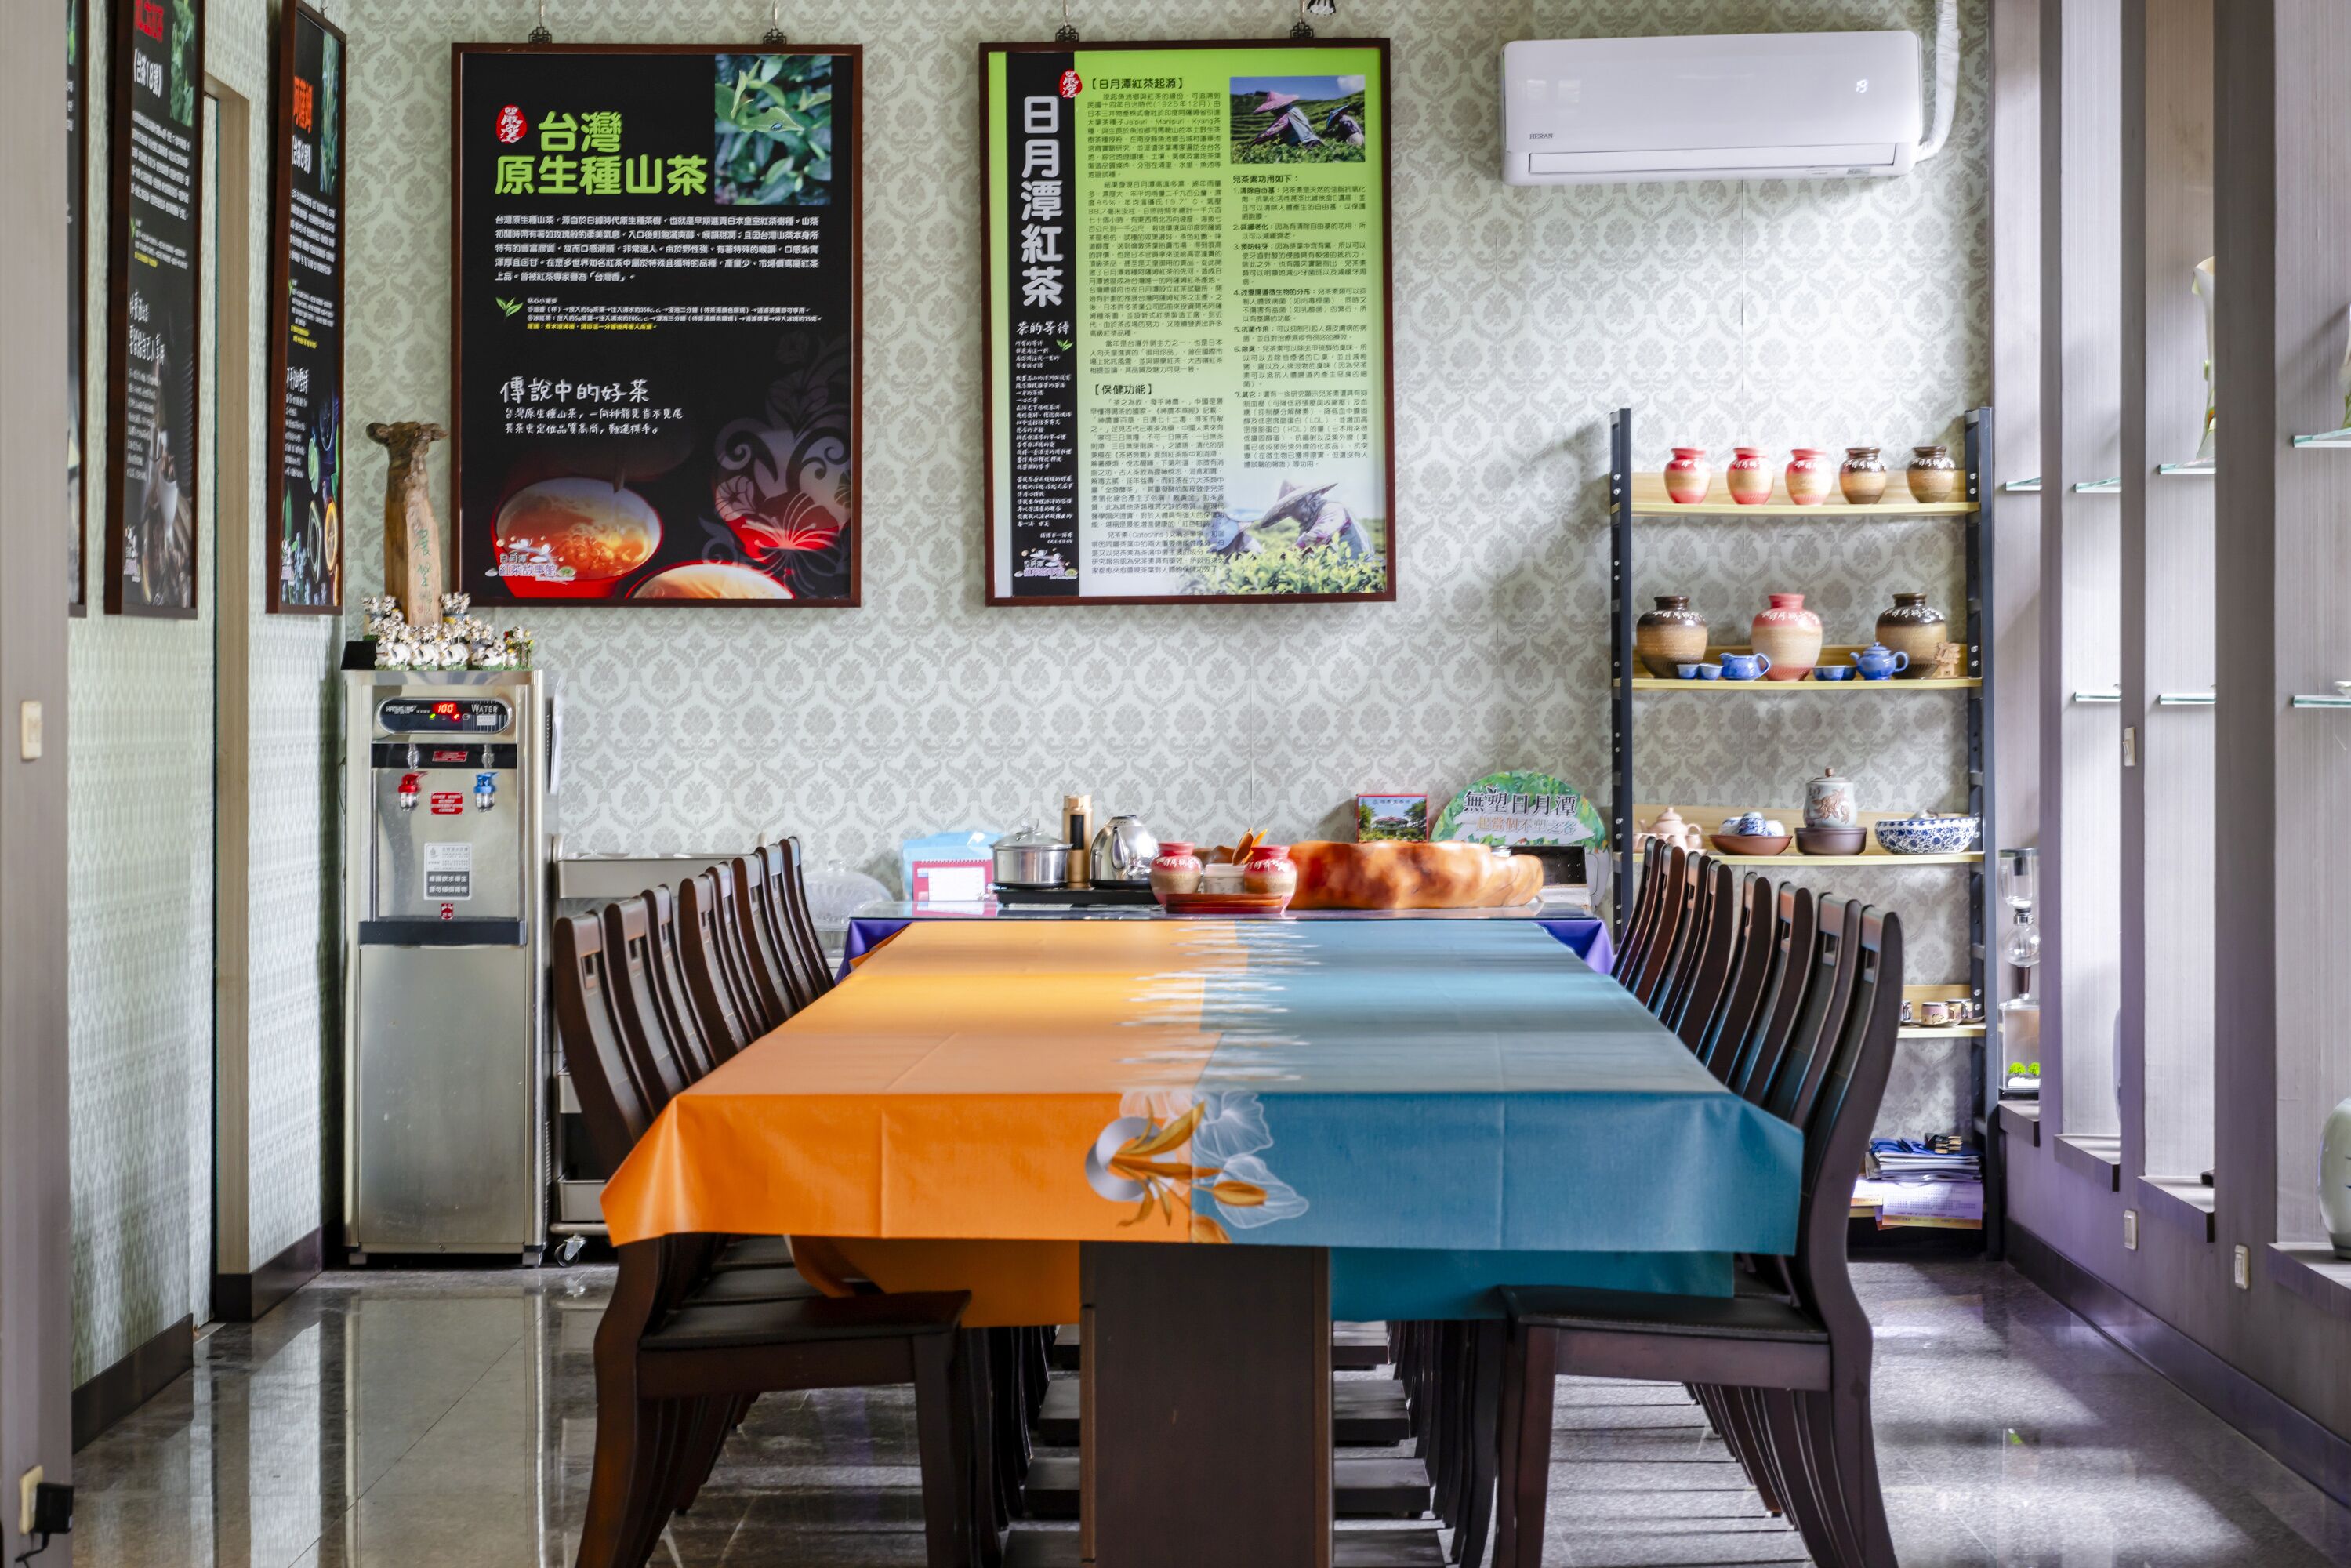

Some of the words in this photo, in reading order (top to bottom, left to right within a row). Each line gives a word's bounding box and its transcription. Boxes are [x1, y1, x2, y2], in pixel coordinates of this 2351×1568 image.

[1092, 78, 1183, 89] 【日月潭紅茶起源】
[538, 111, 622, 153] 台灣
[495, 154, 707, 197] 原生種山茶
[1232, 175, 1297, 183] 兒茶素功用如下：
[1021, 95, 1063, 308] 日月潭紅茶
[1016, 321, 1070, 336] 茶的等待
[500, 376, 650, 404] 傳說中的好茶
[1094, 384, 1152, 395] 【保健功能】
[438, 704, 453, 713] 100
[1464, 790, 1577, 816] 無塑日月潭
[1464, 815, 1577, 835] 一起當個不塑之客
